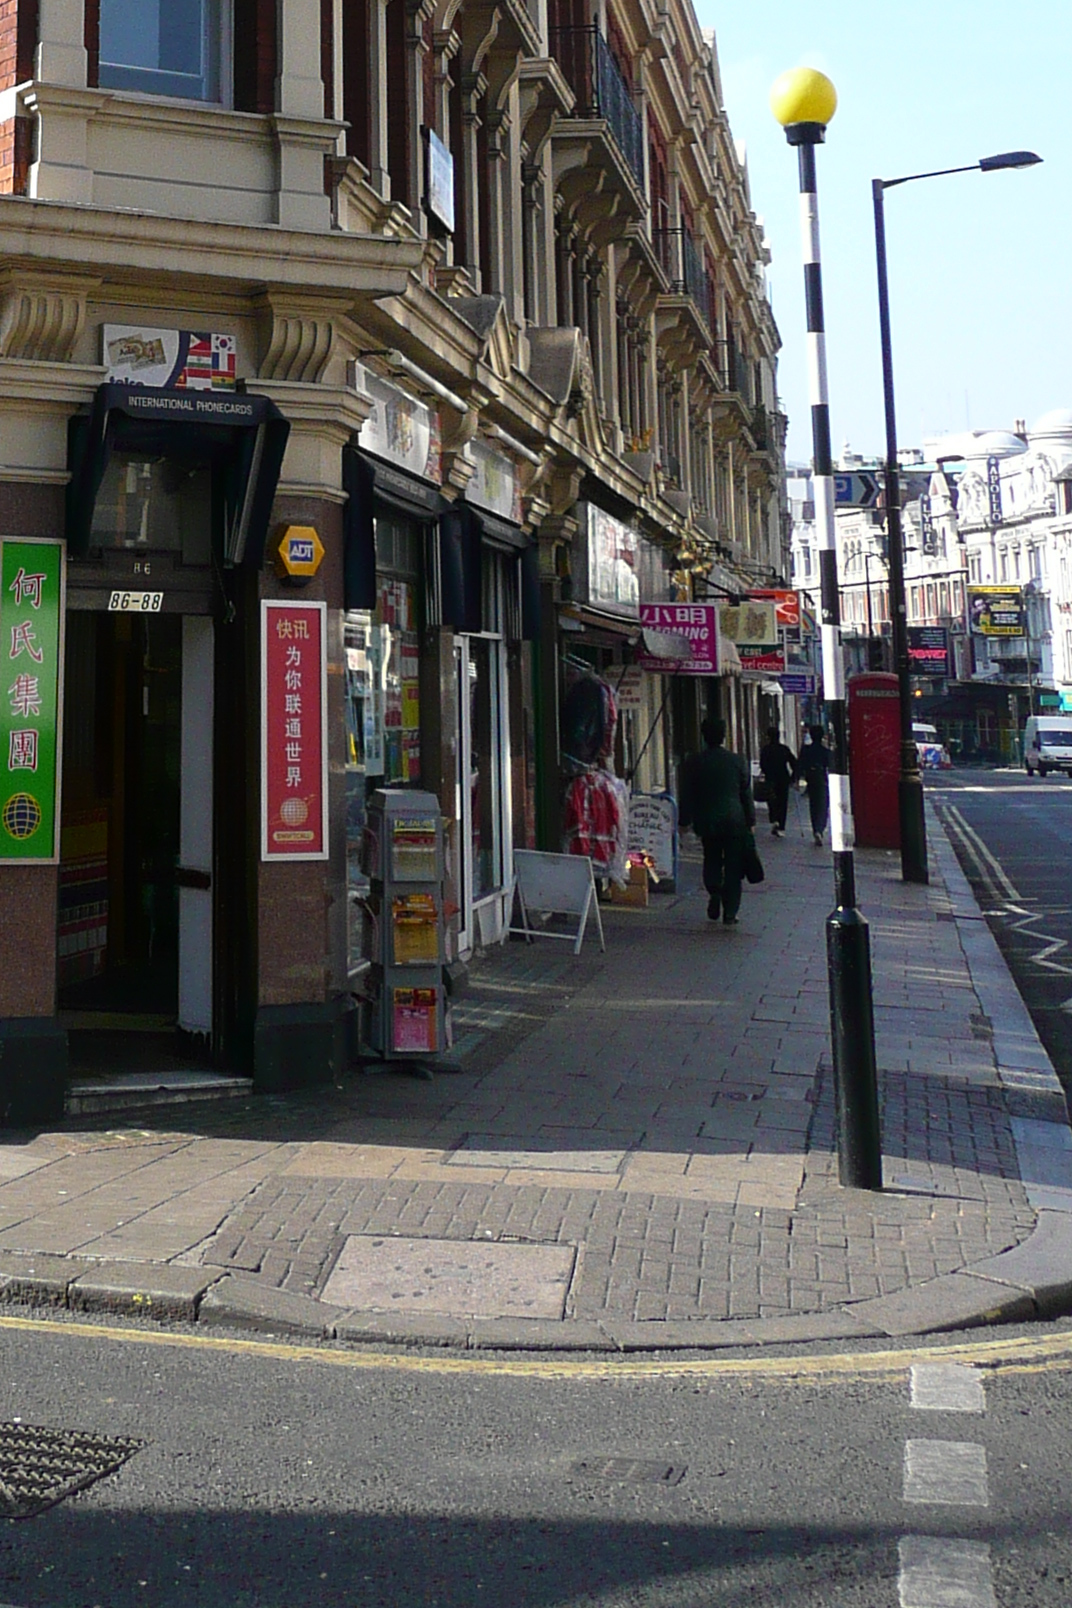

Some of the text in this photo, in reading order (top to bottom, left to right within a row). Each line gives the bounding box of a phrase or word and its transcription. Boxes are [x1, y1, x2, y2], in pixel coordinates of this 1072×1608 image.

[128, 395, 253, 416] INTERNATIONAL PHONECARDS
[989, 466, 1002, 522] APOLLO
[923, 504, 935, 553] LYRIC
[290, 544, 314, 559] ADT
[110, 593, 161, 610] 86-88
[642, 607, 707, 624] 小明
[276, 618, 309, 639] 快讯
[9, 568, 47, 773] 何氏集團
[757, 660, 784, 671] centre
[284, 646, 302, 787] 为你联通世界
